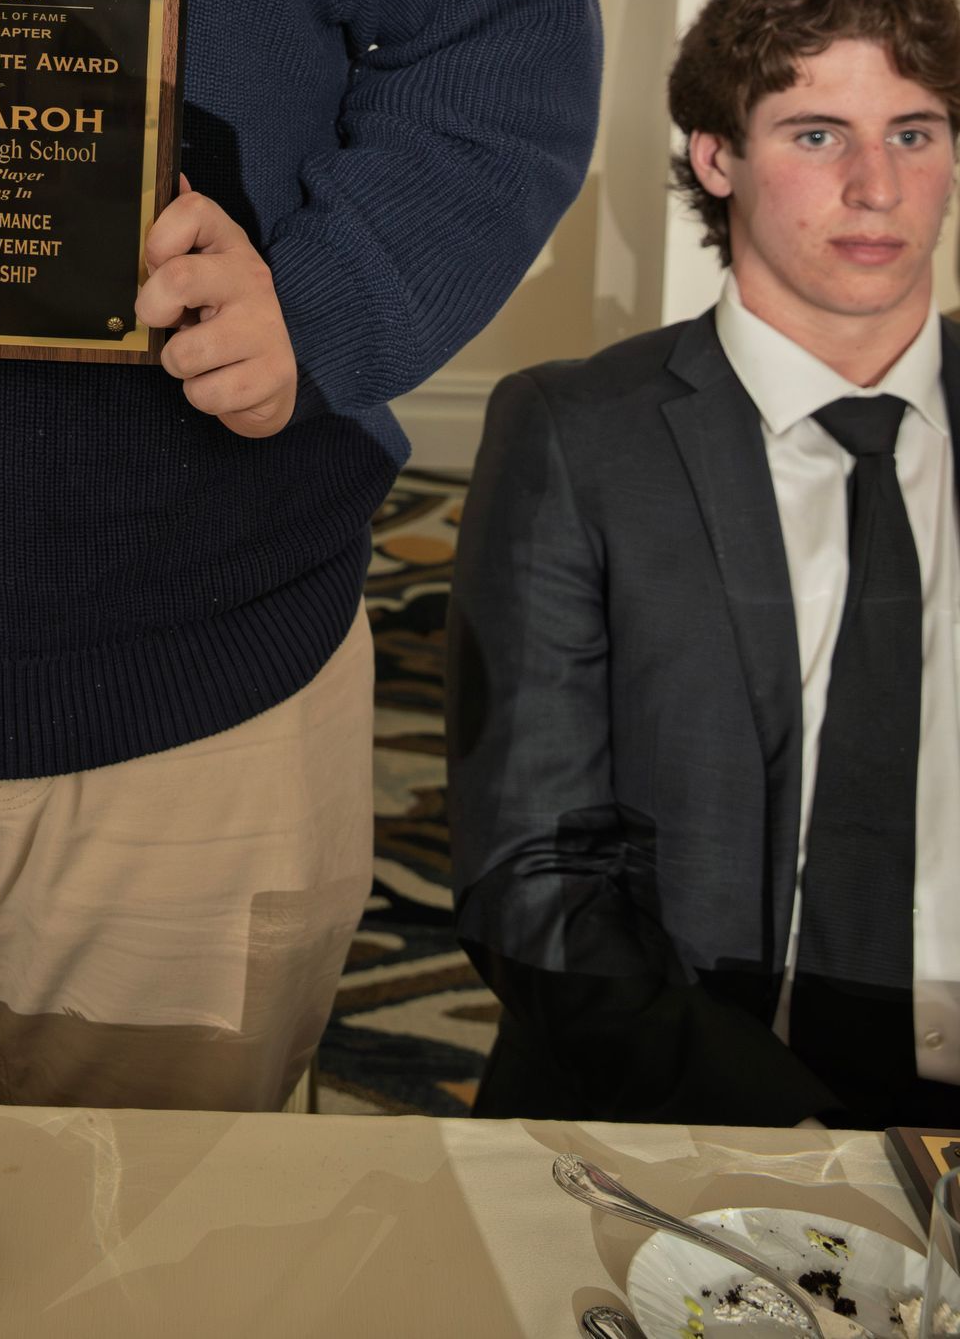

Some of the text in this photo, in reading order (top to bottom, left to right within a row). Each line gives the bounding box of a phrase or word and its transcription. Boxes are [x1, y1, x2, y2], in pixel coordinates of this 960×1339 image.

[12, 12, 28, 21] OF
[33, 13, 68, 22] FAME
[36, 53, 118, 74] AWARD
[30, 140, 96, 162] School
[16, 188, 32, 198] In
